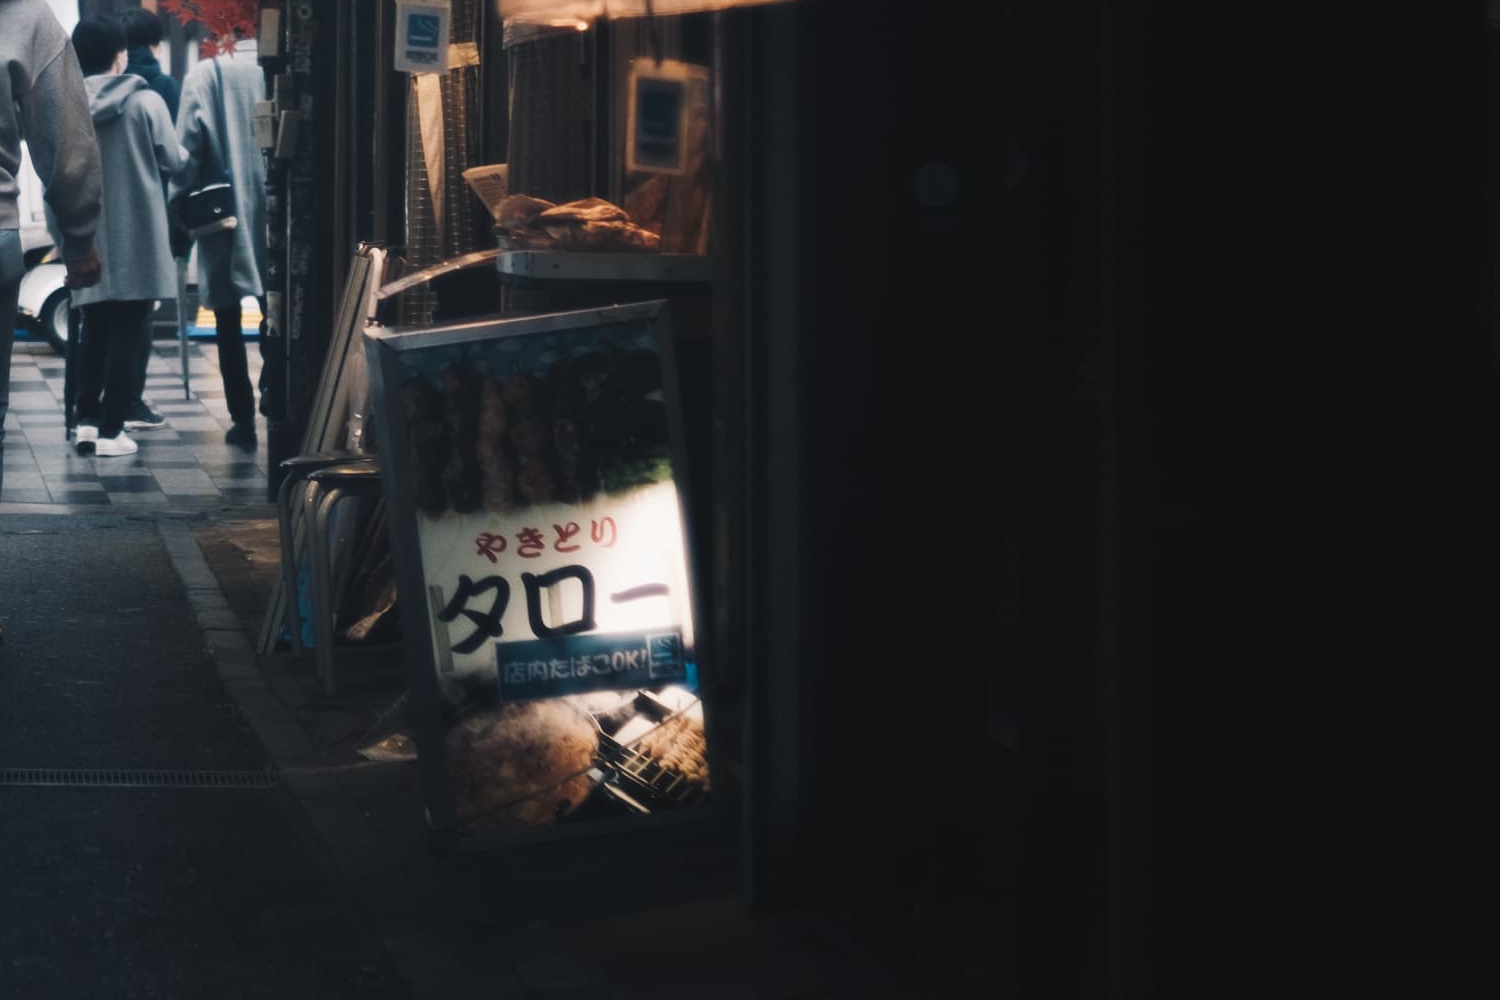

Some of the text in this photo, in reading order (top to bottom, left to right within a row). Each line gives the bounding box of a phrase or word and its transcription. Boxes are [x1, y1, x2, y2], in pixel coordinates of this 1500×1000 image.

[475, 515, 618, 564] やきとり
[437, 564, 670, 655] タロー
